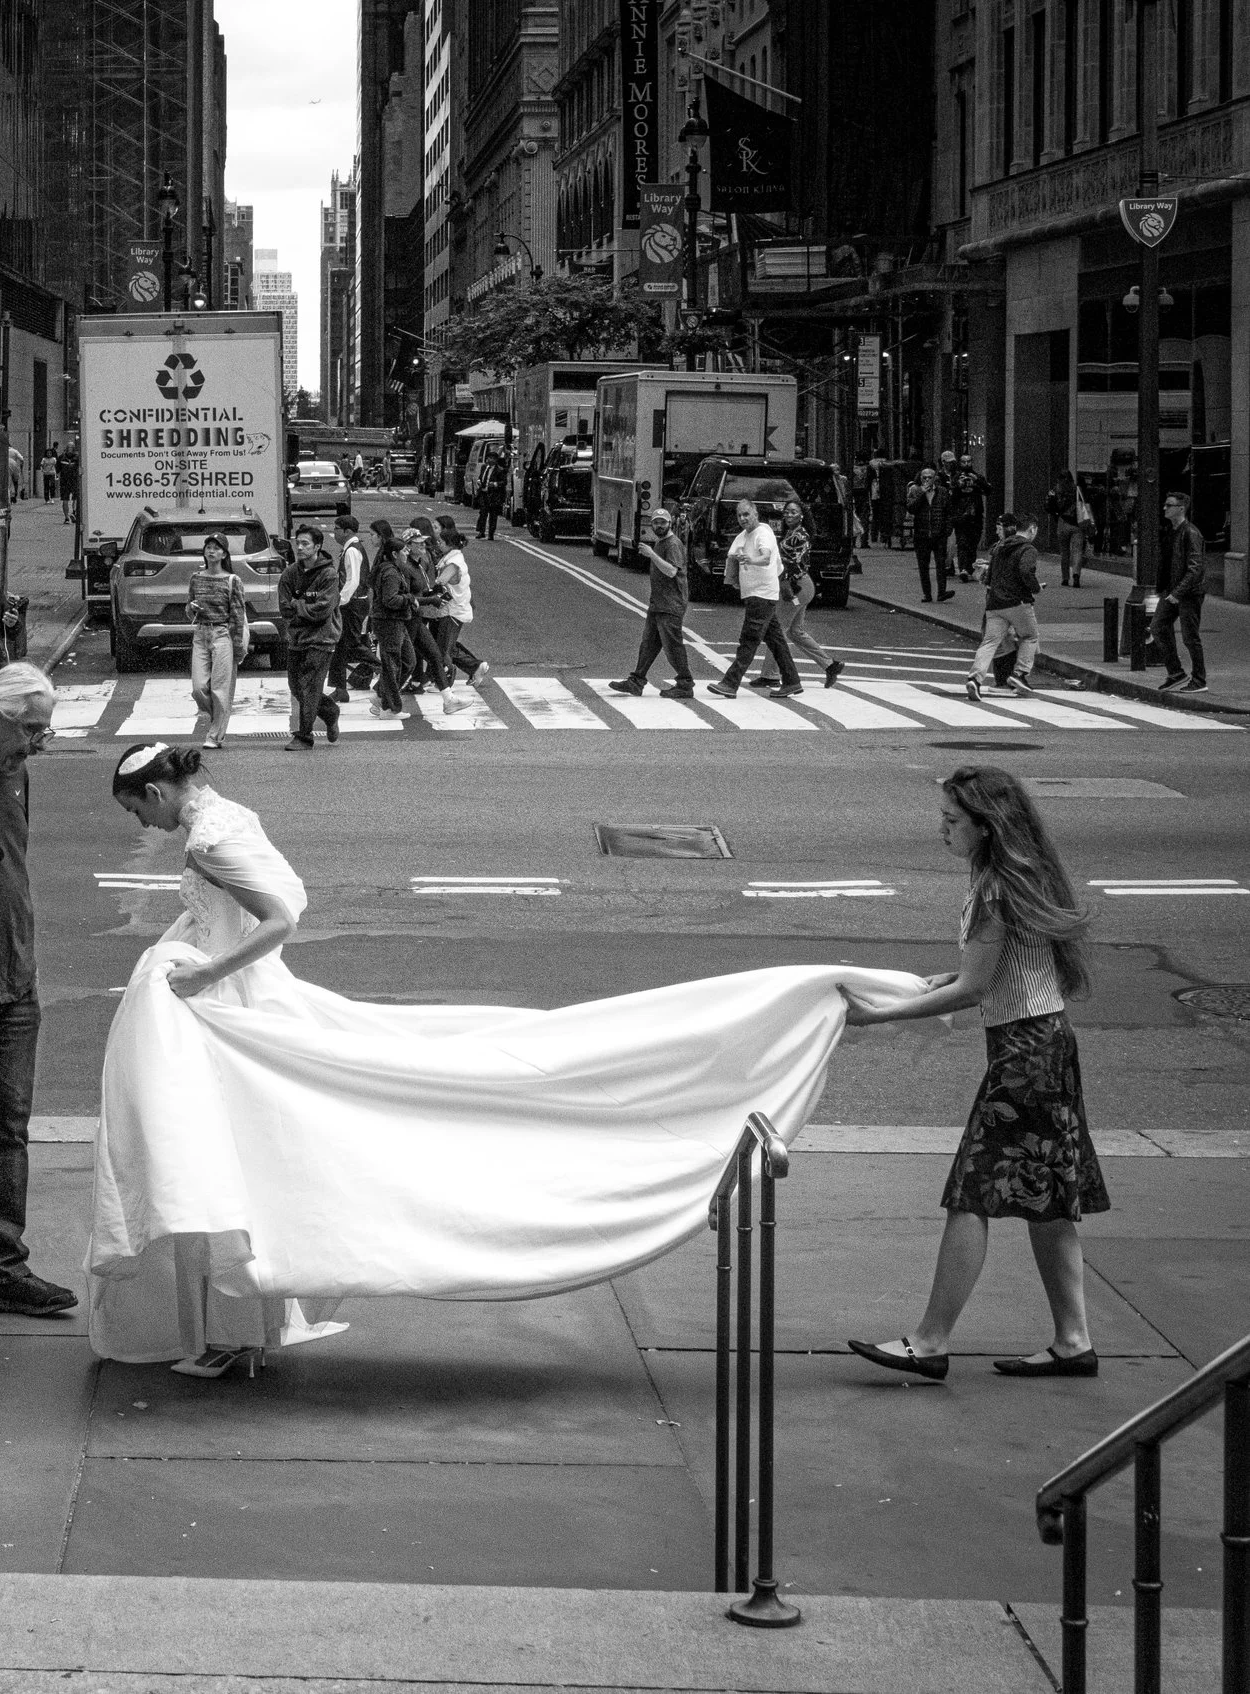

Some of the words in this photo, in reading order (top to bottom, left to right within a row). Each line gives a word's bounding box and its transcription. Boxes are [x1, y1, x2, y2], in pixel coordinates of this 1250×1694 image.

[627, 0, 647, 75] NNIE
[628, 82, 653, 191] MOORE'S
[644, 193, 682, 205] Library
[651, 204, 674, 216] Way
[1130, 203, 1155, 211] Library
[1156, 202, 1173, 211] Way
[130, 247, 160, 258] Library
[136, 256, 154, 266] Way
[100, 407, 244, 424] CONFIDENTIAL
[101, 427, 245, 448] SHREDDING
[101, 451, 145, 459] Documents
[148, 450, 168, 458] Don't
[171, 450, 187, 458] Get
[188, 450, 208, 459] Away
[210, 449, 230, 457] From
[233, 449, 246, 457] Us!
[155, 459, 208, 471] ON-SITE
[105, 472, 254, 487] 1-866-57-SHRED
[106, 490, 254, 500] www.shredconfidential.com
